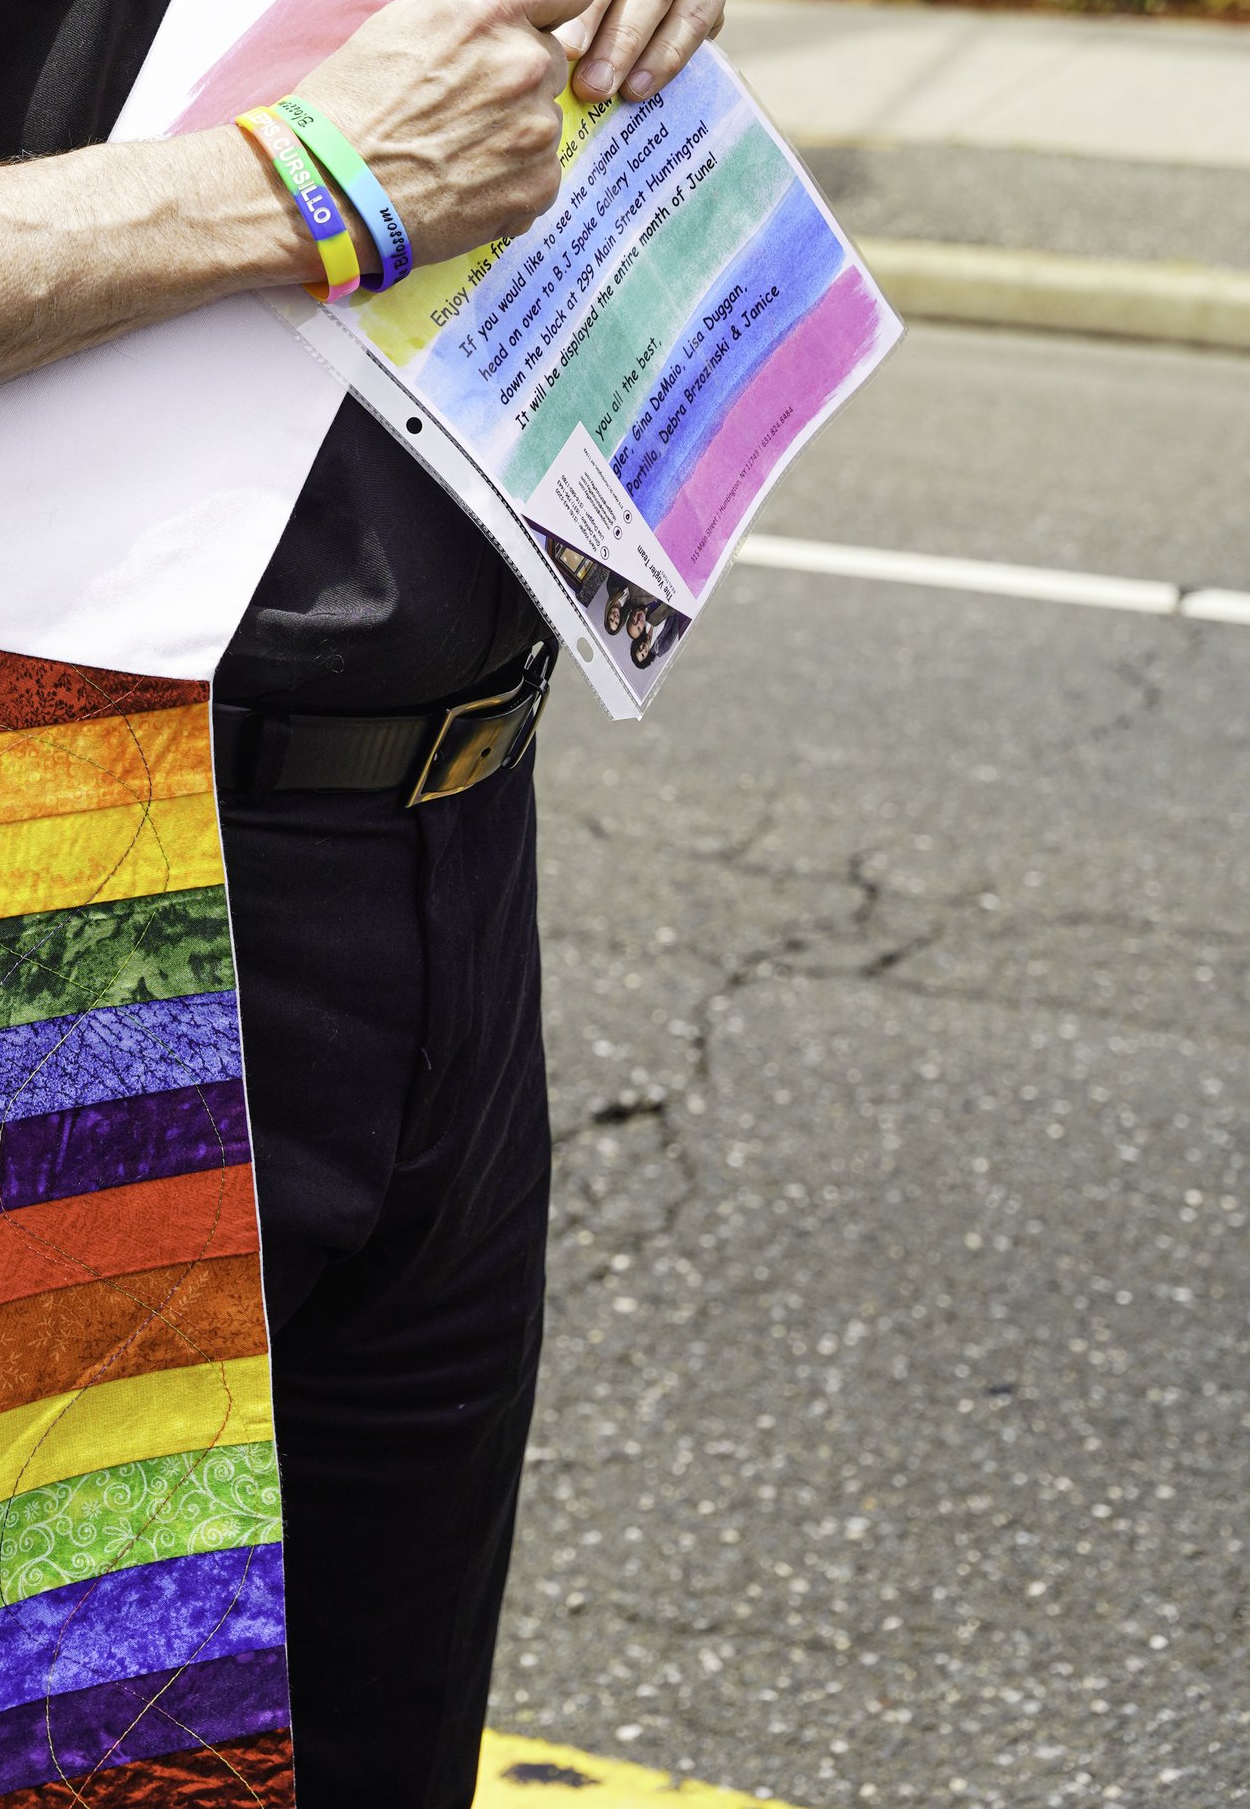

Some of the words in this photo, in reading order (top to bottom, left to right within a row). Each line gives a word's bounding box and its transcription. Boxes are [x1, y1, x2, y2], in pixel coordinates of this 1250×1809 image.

[272, 137, 331, 224] CURSILLO
[559, 139, 579, 168] ride
[578, 118, 589, 140] of
[587, 99, 612, 126] New
[378, 207, 409, 271] Blossom
[459, 334, 477, 358] If
[478, 312, 499, 342] you
[497, 271, 526, 312] would
[523, 250, 544, 276] like
[543, 234, 556, 249] to
[556, 210, 572, 234] see
[571, 186, 587, 209] the
[588, 136, 620, 186] original
[620, 92, 664, 142] painting
[478, 343, 509, 381] head
[509, 328, 522, 346] on
[523, 298, 541, 328] over
[542, 282, 554, 298] to
[553, 251, 571, 281] B.J
[571, 217, 597, 256] Spoke
[596, 172, 629, 217] Gallery
[627, 122, 669, 173] located
[500, 371, 526, 405] down
[525, 346, 543, 370] the
[540, 310, 567, 346] block
[567, 292, 578, 310] at
[577, 264, 594, 293] 299
[594, 235, 616, 267] Main
[615, 191, 646, 235] Street
[646, 119, 708, 193] Huntington!
[430, 287, 469, 327] Enjoy
[468, 259, 492, 286] this
[515, 411, 529, 430] It
[530, 383, 547, 412] will
[544, 368, 560, 388] be
[560, 305, 599, 367] displayed
[597, 285, 614, 308] the
[614, 247, 639, 284] entire
[639, 207, 670, 246] month
[670, 185, 685, 207] of
[686, 151, 717, 190] June!
[595, 412, 612, 442] you
[612, 390, 623, 412] all
[622, 370, 639, 393] the
[636, 337, 661, 370] best,
[612, 446, 634, 480] gler,
[632, 411, 654, 441] Gina
[650, 364, 685, 411] DeMaio,
[683, 331, 705, 359] Lisa
[703, 285, 747, 331] Duggan,
[626, 450, 662, 497] Portillo,
[659, 404, 687, 444] Debra
[684, 337, 730, 404] Brzozinski
[730, 325, 742, 340] &
[741, 286, 780, 328] Janice
[637, 545, 650, 567] Team
[649, 565, 667, 589] Vogler
[663, 586, 673, 602] The
